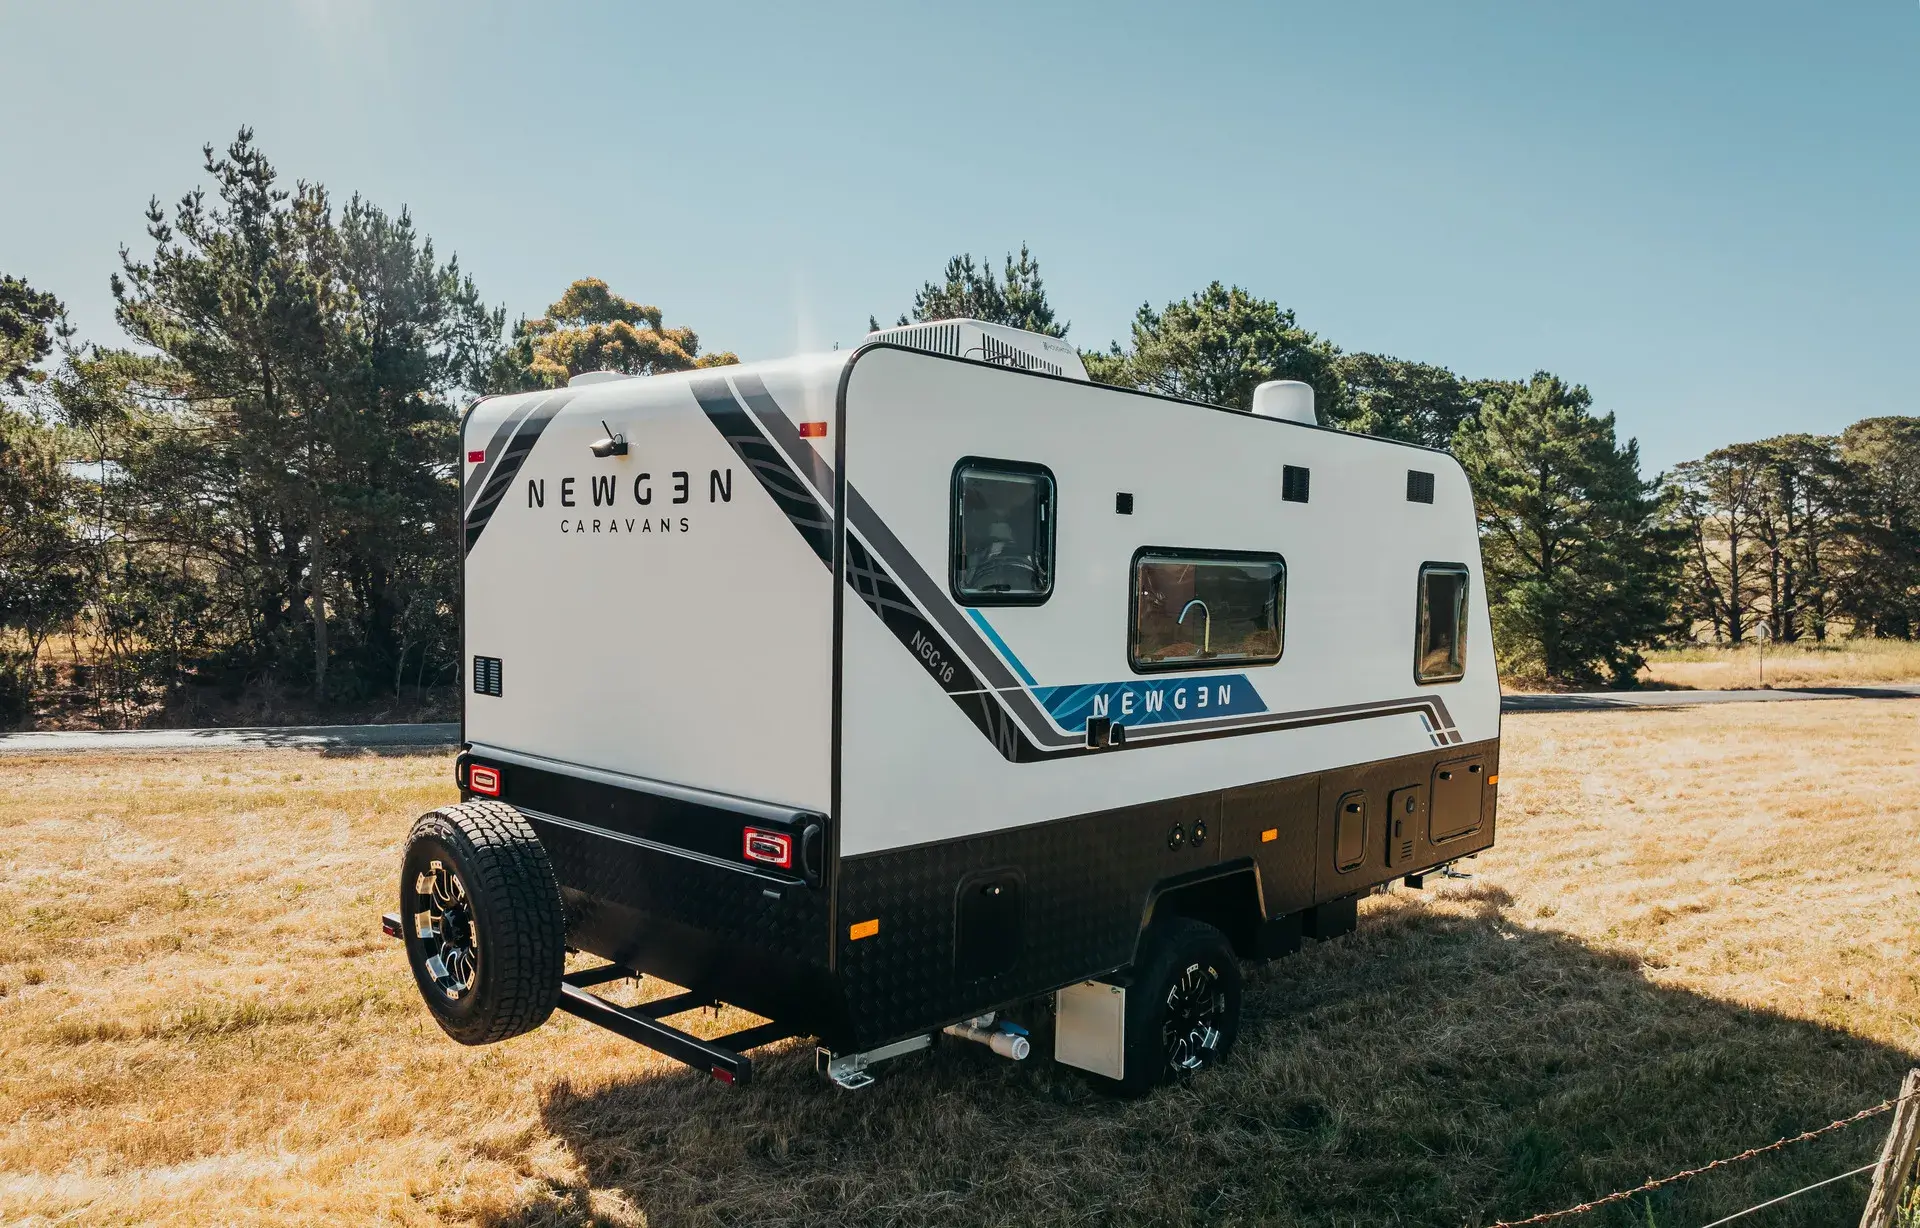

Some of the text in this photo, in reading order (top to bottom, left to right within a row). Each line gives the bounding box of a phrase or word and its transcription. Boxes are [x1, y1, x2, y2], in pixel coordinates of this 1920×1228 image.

[560, 517, 689, 533] CARAVANS
[910, 630, 955, 683] NGC 16
